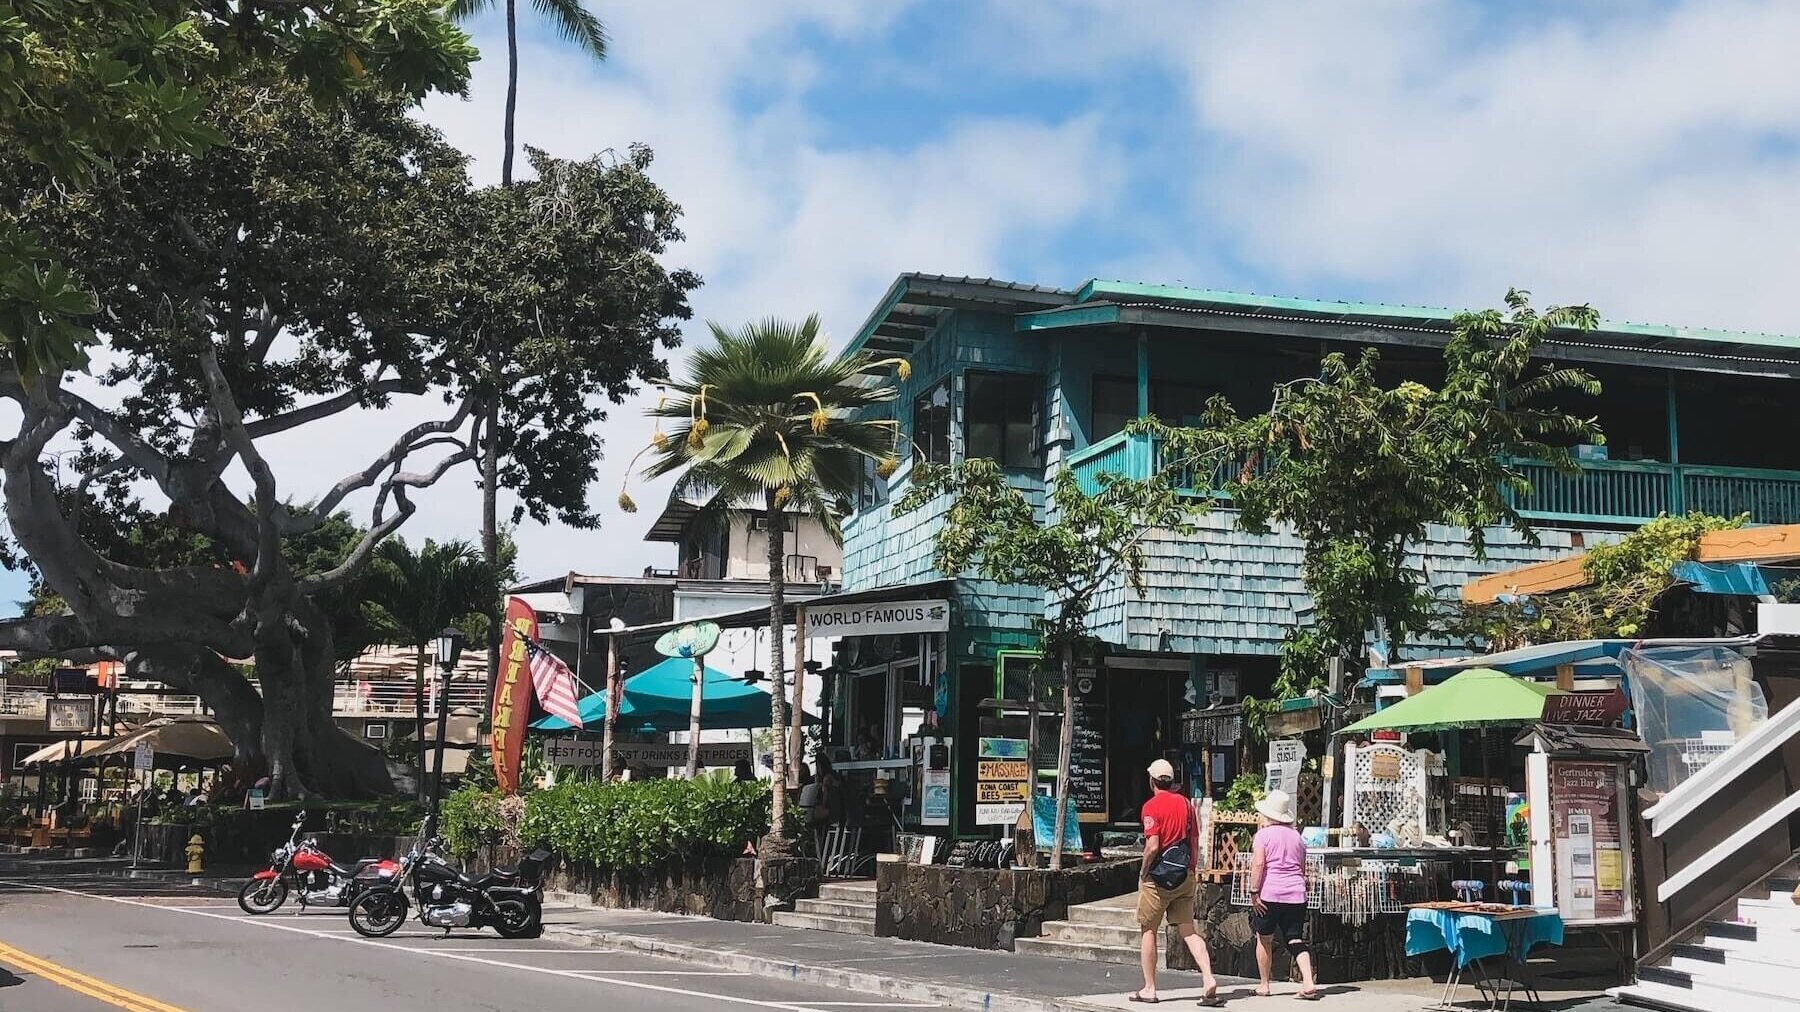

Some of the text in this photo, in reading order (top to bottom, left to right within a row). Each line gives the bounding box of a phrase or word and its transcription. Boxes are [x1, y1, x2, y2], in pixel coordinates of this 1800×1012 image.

[809, 608, 924, 627] WORLD FAMOUS
[1559, 696, 1605, 708] DINNER
[1545, 709, 1606, 721] LIVE JAZZ
[55, 718, 85, 727] CUISINE
[547, 747, 574, 757] BEST
[642, 751, 680, 760] DRINKS
[682, 750, 712, 760] BST
[712, 749, 749, 759] PRICES
[1276, 751, 1297, 762] SUSHI
[985, 762, 1026, 778] MASSAGE
[980, 782, 1018, 791] KONA COAST
[1563, 777, 1594, 788] Jazz Bar
[981, 791, 1000, 800] BEES
